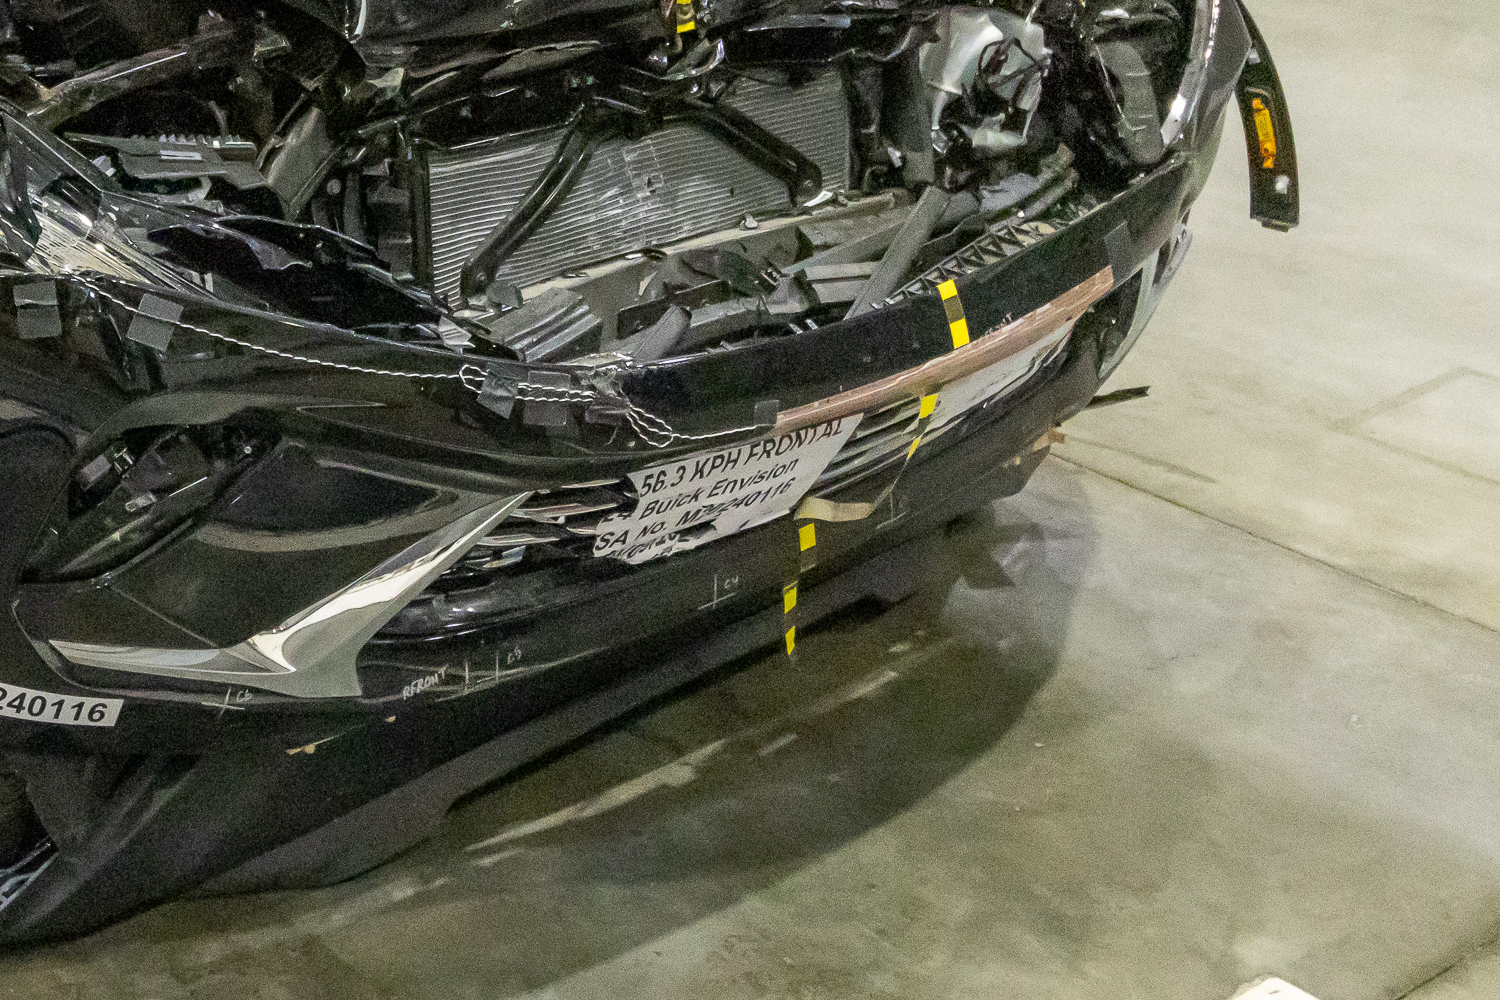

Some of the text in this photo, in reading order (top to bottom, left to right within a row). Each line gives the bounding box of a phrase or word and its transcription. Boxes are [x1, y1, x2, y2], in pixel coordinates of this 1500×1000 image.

[639, 419, 843, 497] 56.3 KPH FRONTAL
[639, 487, 705, 521] Buick
[707, 458, 799, 499] Envision
[635, 521, 666, 541] No.
